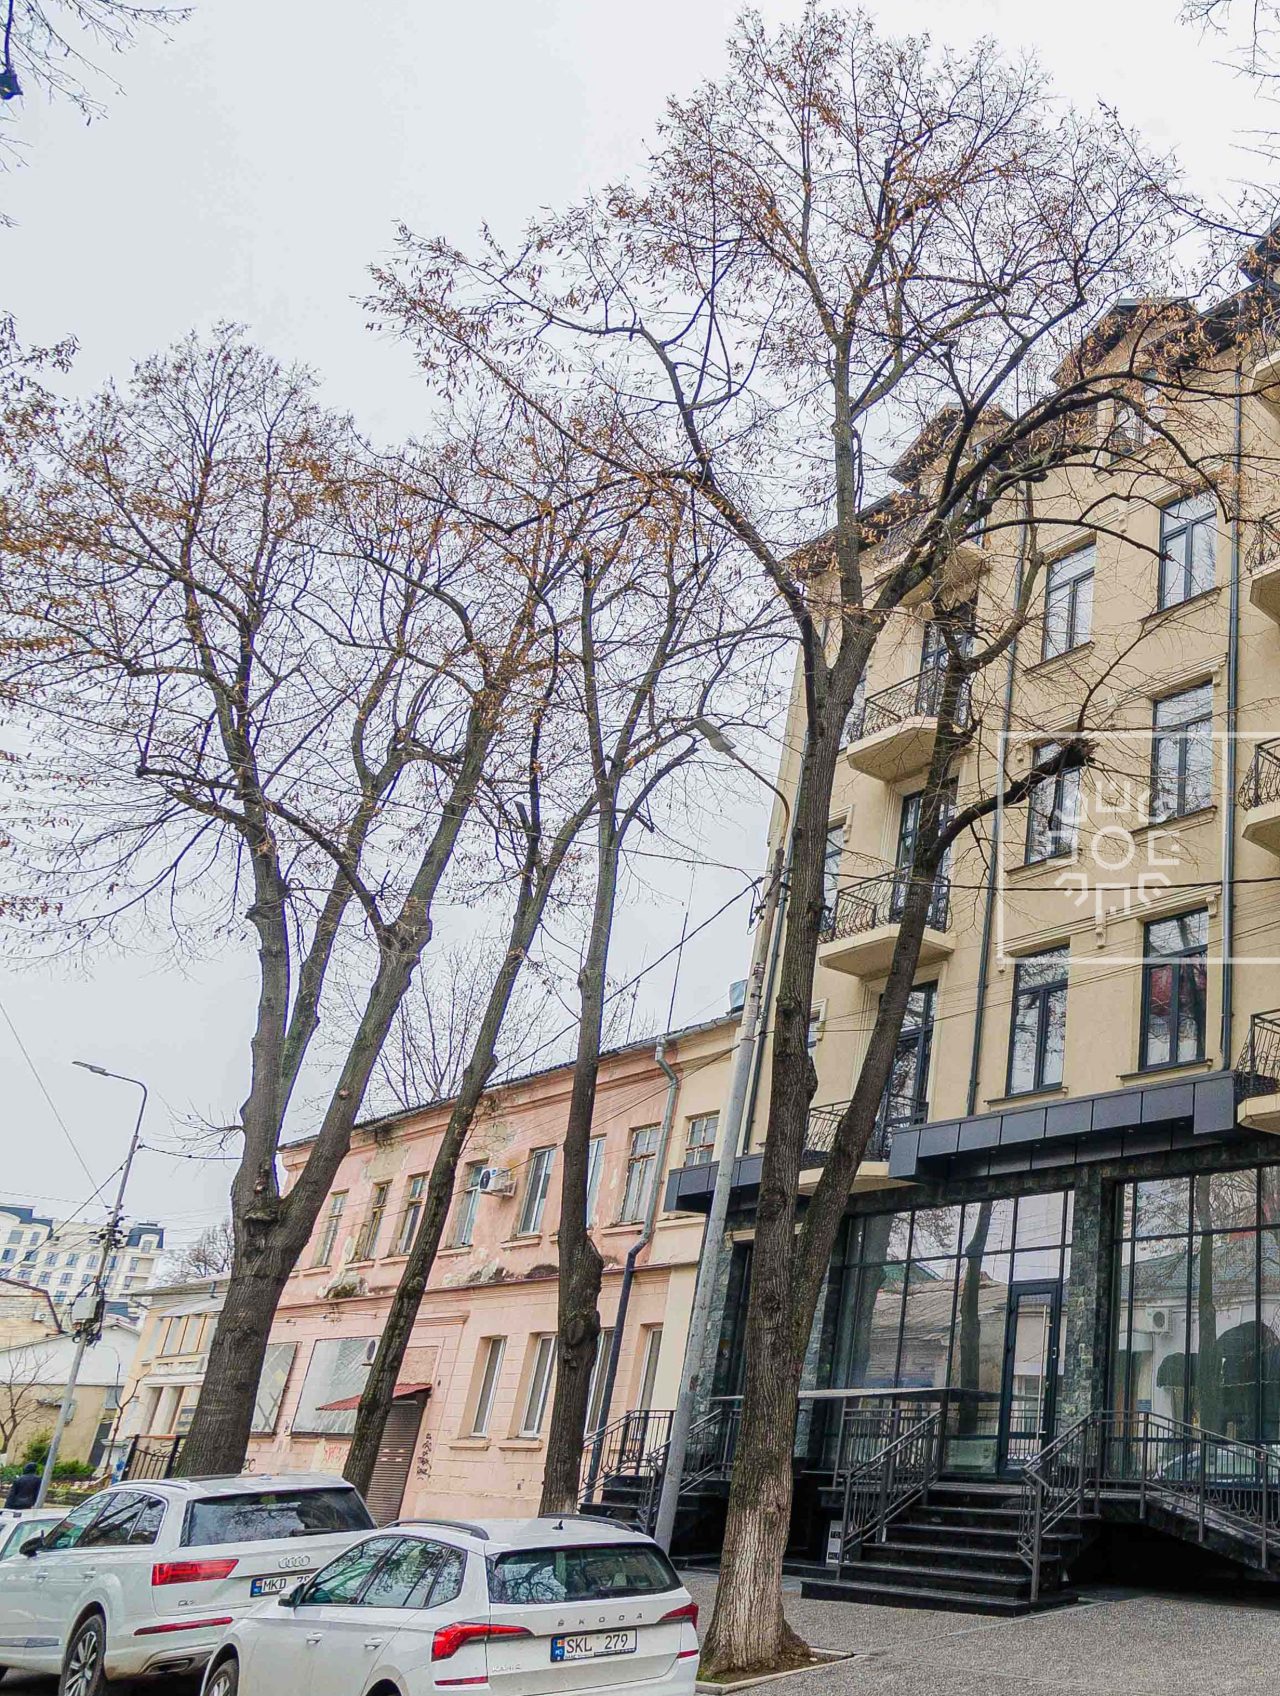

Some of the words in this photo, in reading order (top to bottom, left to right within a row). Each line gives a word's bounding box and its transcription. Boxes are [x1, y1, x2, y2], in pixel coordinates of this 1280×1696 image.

[264, 1578, 287, 1591] MKD
[566, 1637, 593, 1654] SKL
[604, 1633, 628, 1650] 279
